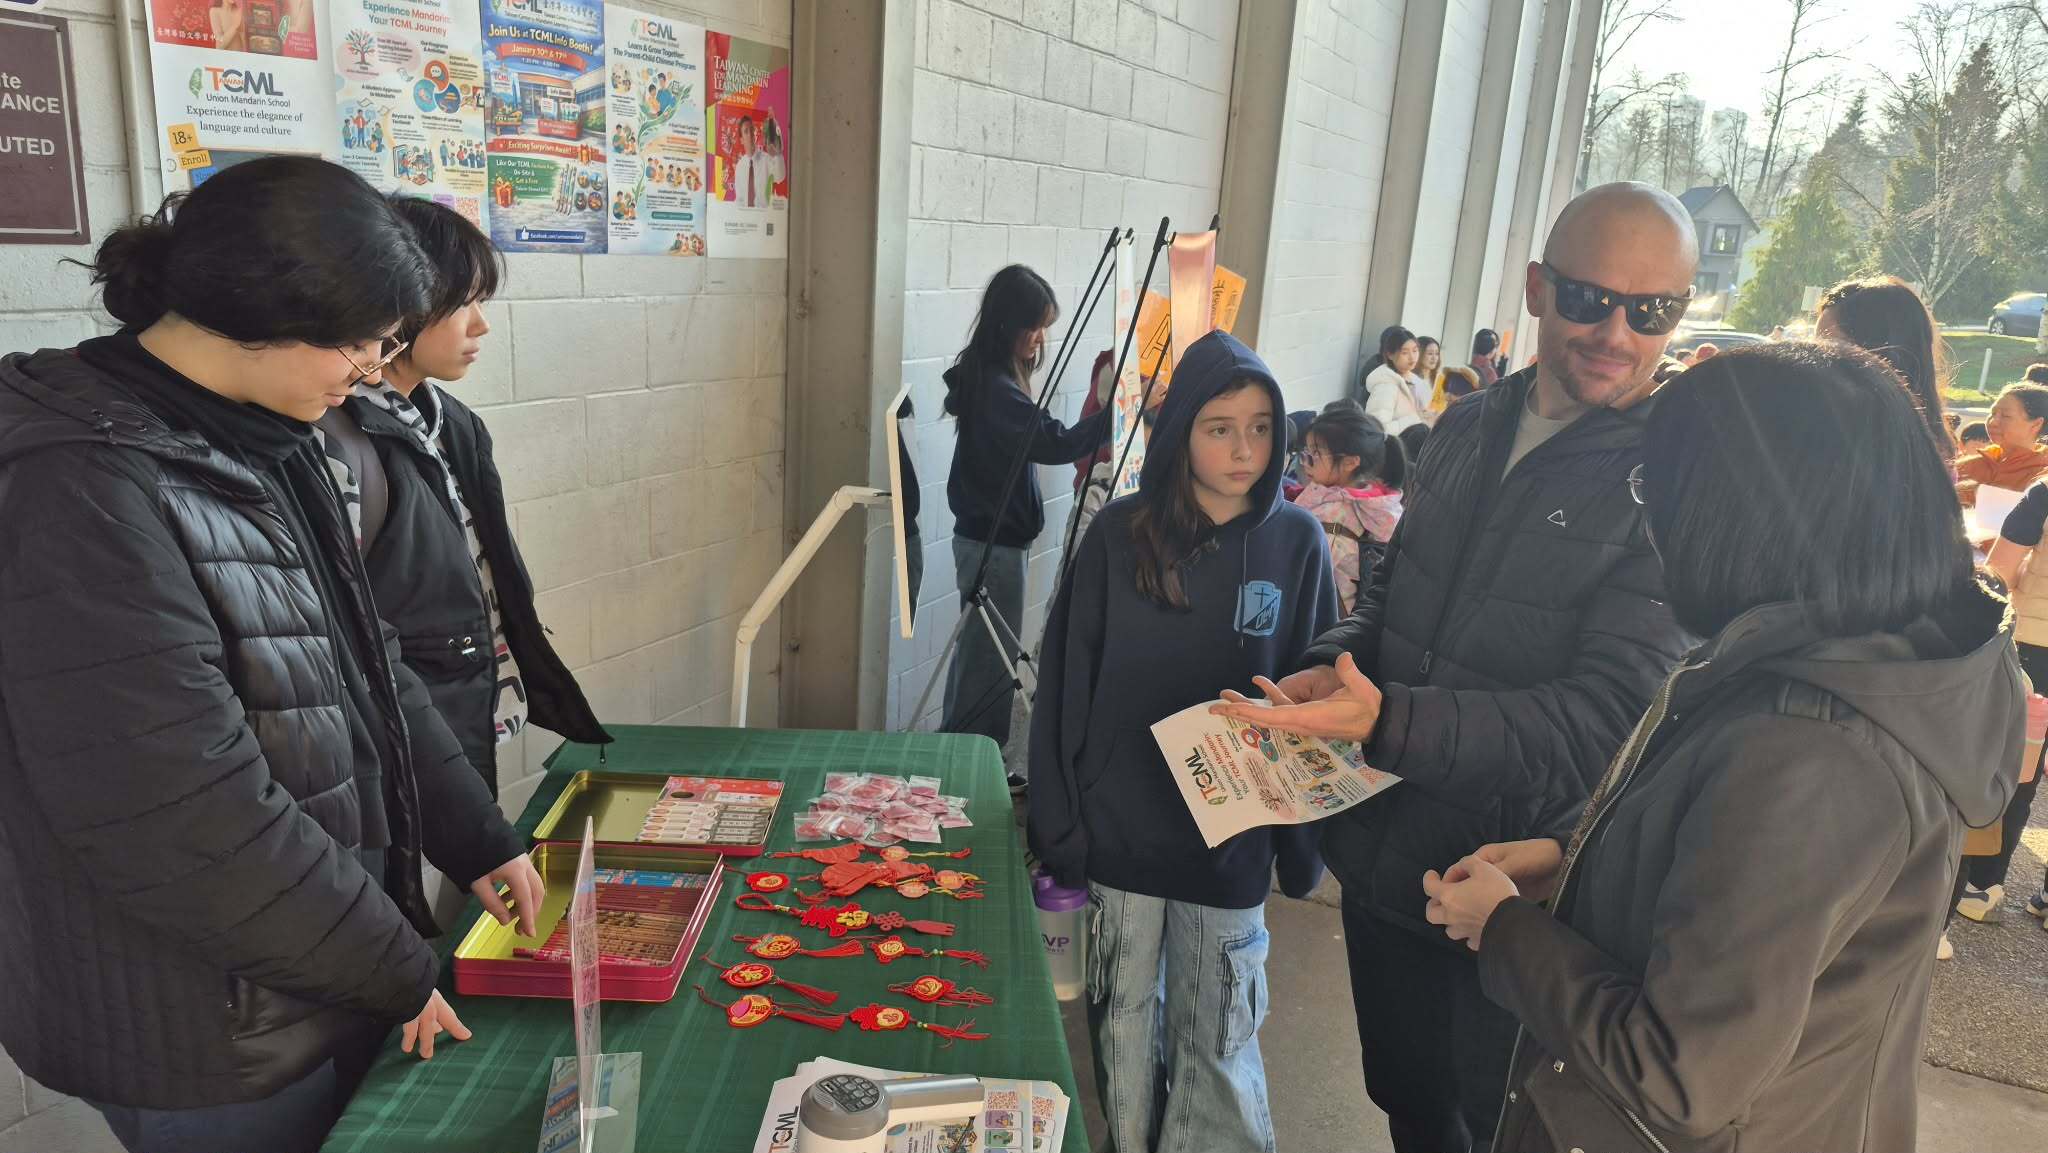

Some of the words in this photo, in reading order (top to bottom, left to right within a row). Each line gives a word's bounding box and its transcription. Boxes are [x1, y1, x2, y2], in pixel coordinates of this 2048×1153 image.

[363, 0, 410, 16] Experience
[369, 14, 388, 25] Your
[390, 18, 412, 30] TCML
[415, 23, 447, 37] Journey
[640, 18, 677, 41] TCML
[488, 24, 508, 37] Join
[510, 25, 520, 37] Us
[530, 28, 553, 42] TCML
[554, 35, 567, 46] Info
[569, 38, 593, 56] Booth!
[628, 41, 642, 51] Learn
[648, 45, 662, 55] Grow
[512, 44, 536, 56] January
[613, 47, 623, 56] The
[624, 50, 655, 63] Parent-Child
[714, 55, 749, 74] TAIWAN
[0, 72, 22, 89] te
[204, 66, 284, 97] TCML
[715, 78, 754, 96] LEARNING
[1, 92, 61, 114] ANCE
[206, 93, 229, 103] Union
[231, 95, 266, 106] Mandarin
[268, 98, 291, 108] School
[186, 105, 238, 118] Experience
[240, 108, 255, 119] the
[257, 109, 292, 122] elegance
[294, 113, 303, 122] of
[200, 121, 241, 135] language
[243, 123, 259, 134] and
[261, 124, 292, 136] culture
[172, 131, 193, 145] 18+
[508, 141, 530, 150] Exciting
[531, 142, 555, 153] Surprises
[181, 153, 208, 166] Enroll
[1185, 746, 1218, 800] TCML
